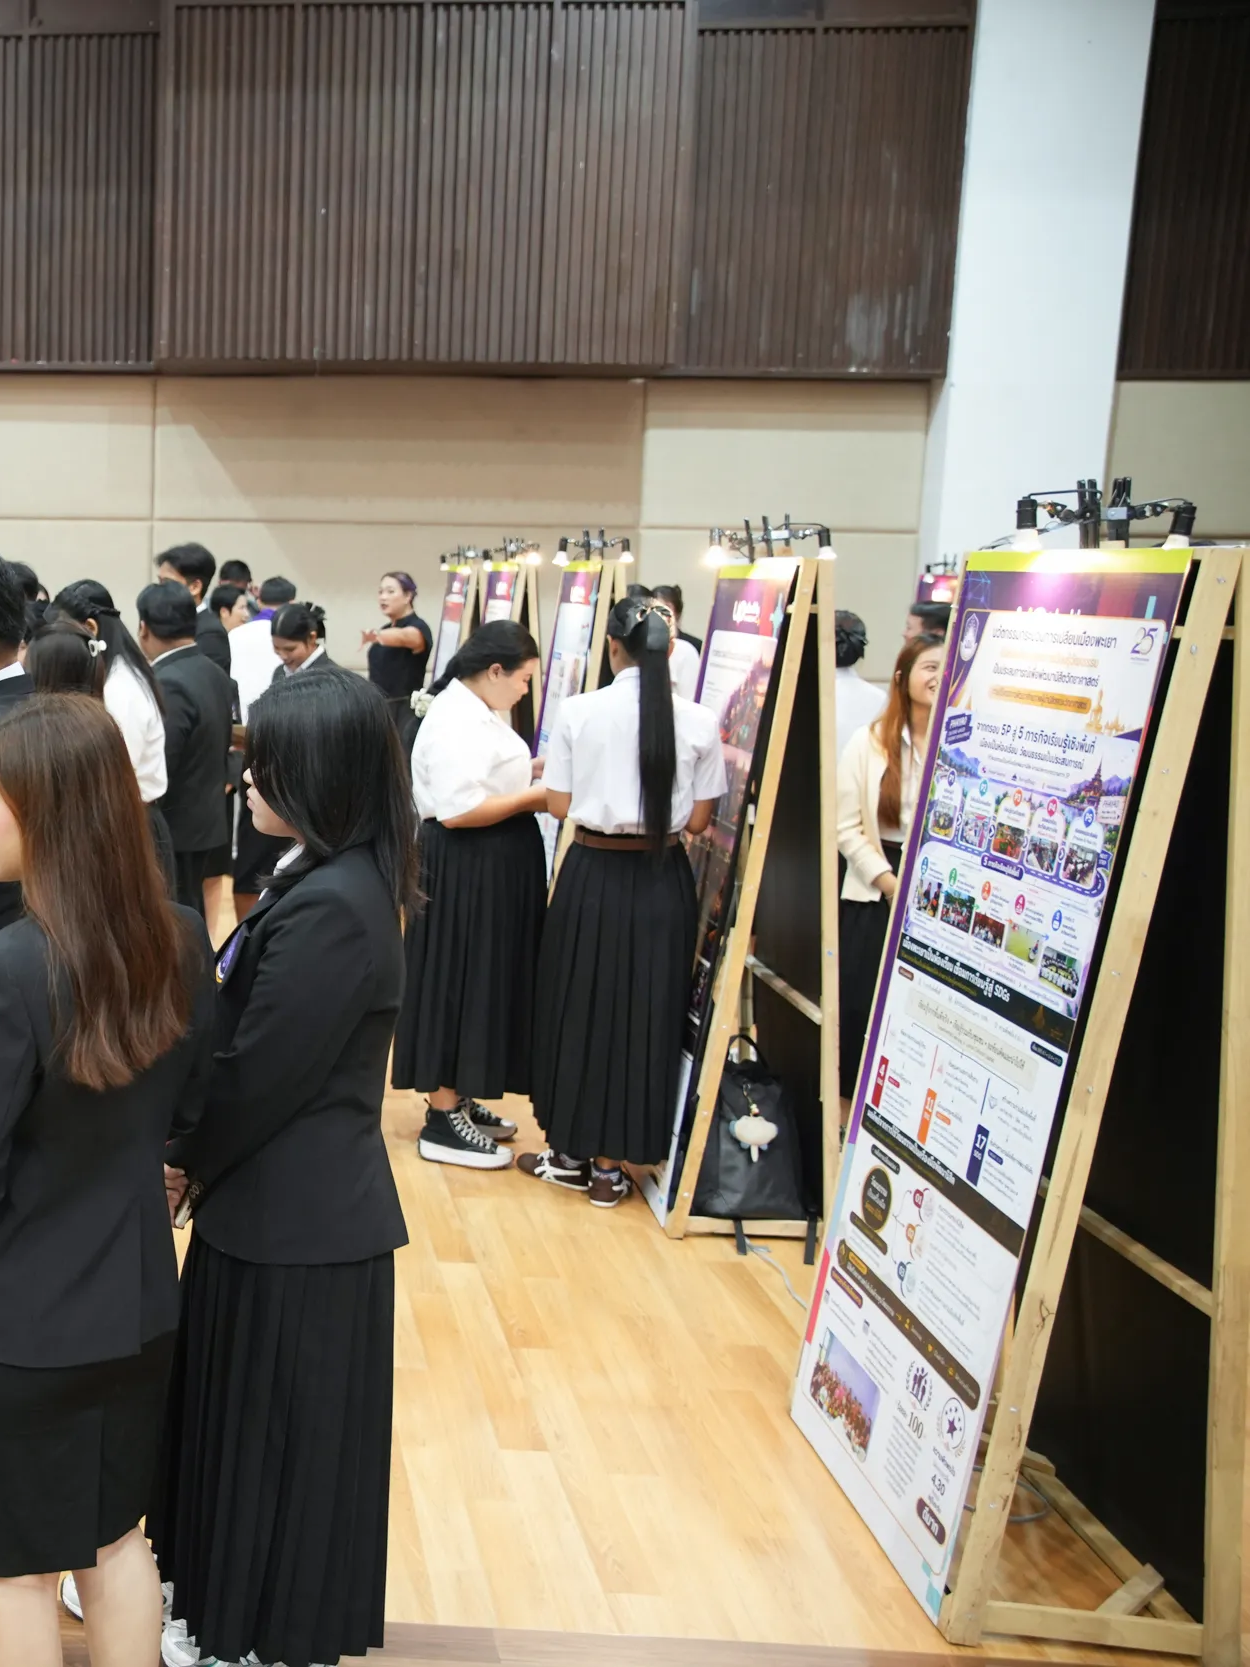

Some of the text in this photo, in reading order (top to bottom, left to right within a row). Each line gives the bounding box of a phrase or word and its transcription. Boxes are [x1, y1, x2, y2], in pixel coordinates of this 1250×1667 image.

[999, 723, 1013, 736] 5P
[1016, 726, 1025, 739] 5
[993, 984, 1010, 1003] SDGs
[878, 1062, 886, 1077] 4
[924, 1096, 934, 1112] 11
[974, 1133, 987, 1151] 17
[908, 1410, 923, 1440] 100
[931, 1472, 945, 1497] 4.30
